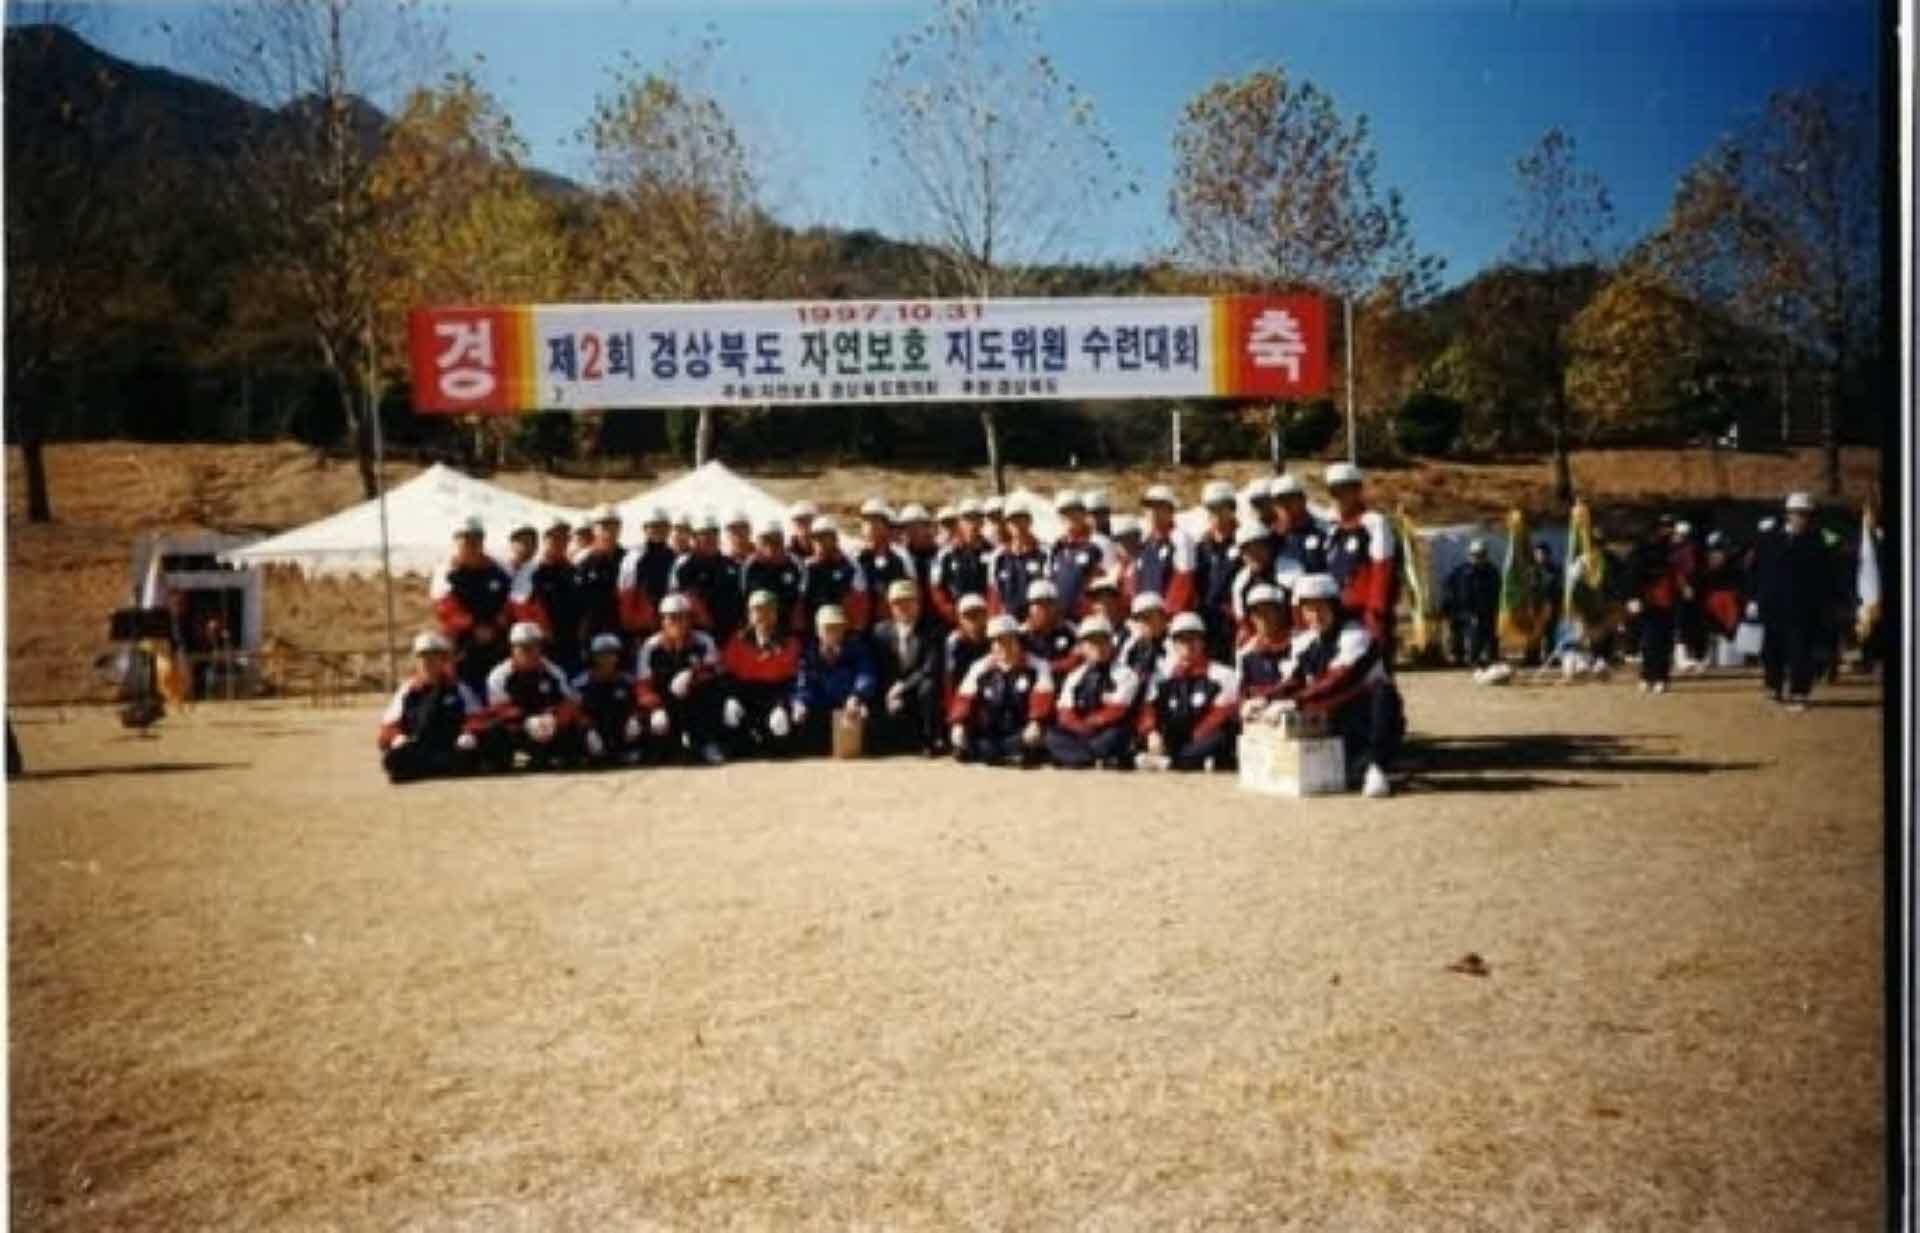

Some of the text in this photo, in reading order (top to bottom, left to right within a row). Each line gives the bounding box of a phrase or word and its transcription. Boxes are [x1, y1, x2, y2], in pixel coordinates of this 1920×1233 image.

[433, 319, 497, 398] 경
[547, 323, 1199, 381] 제2회 경상북도 자연보호 지도위원 수련대회
[1247, 311, 1306, 384] 축
